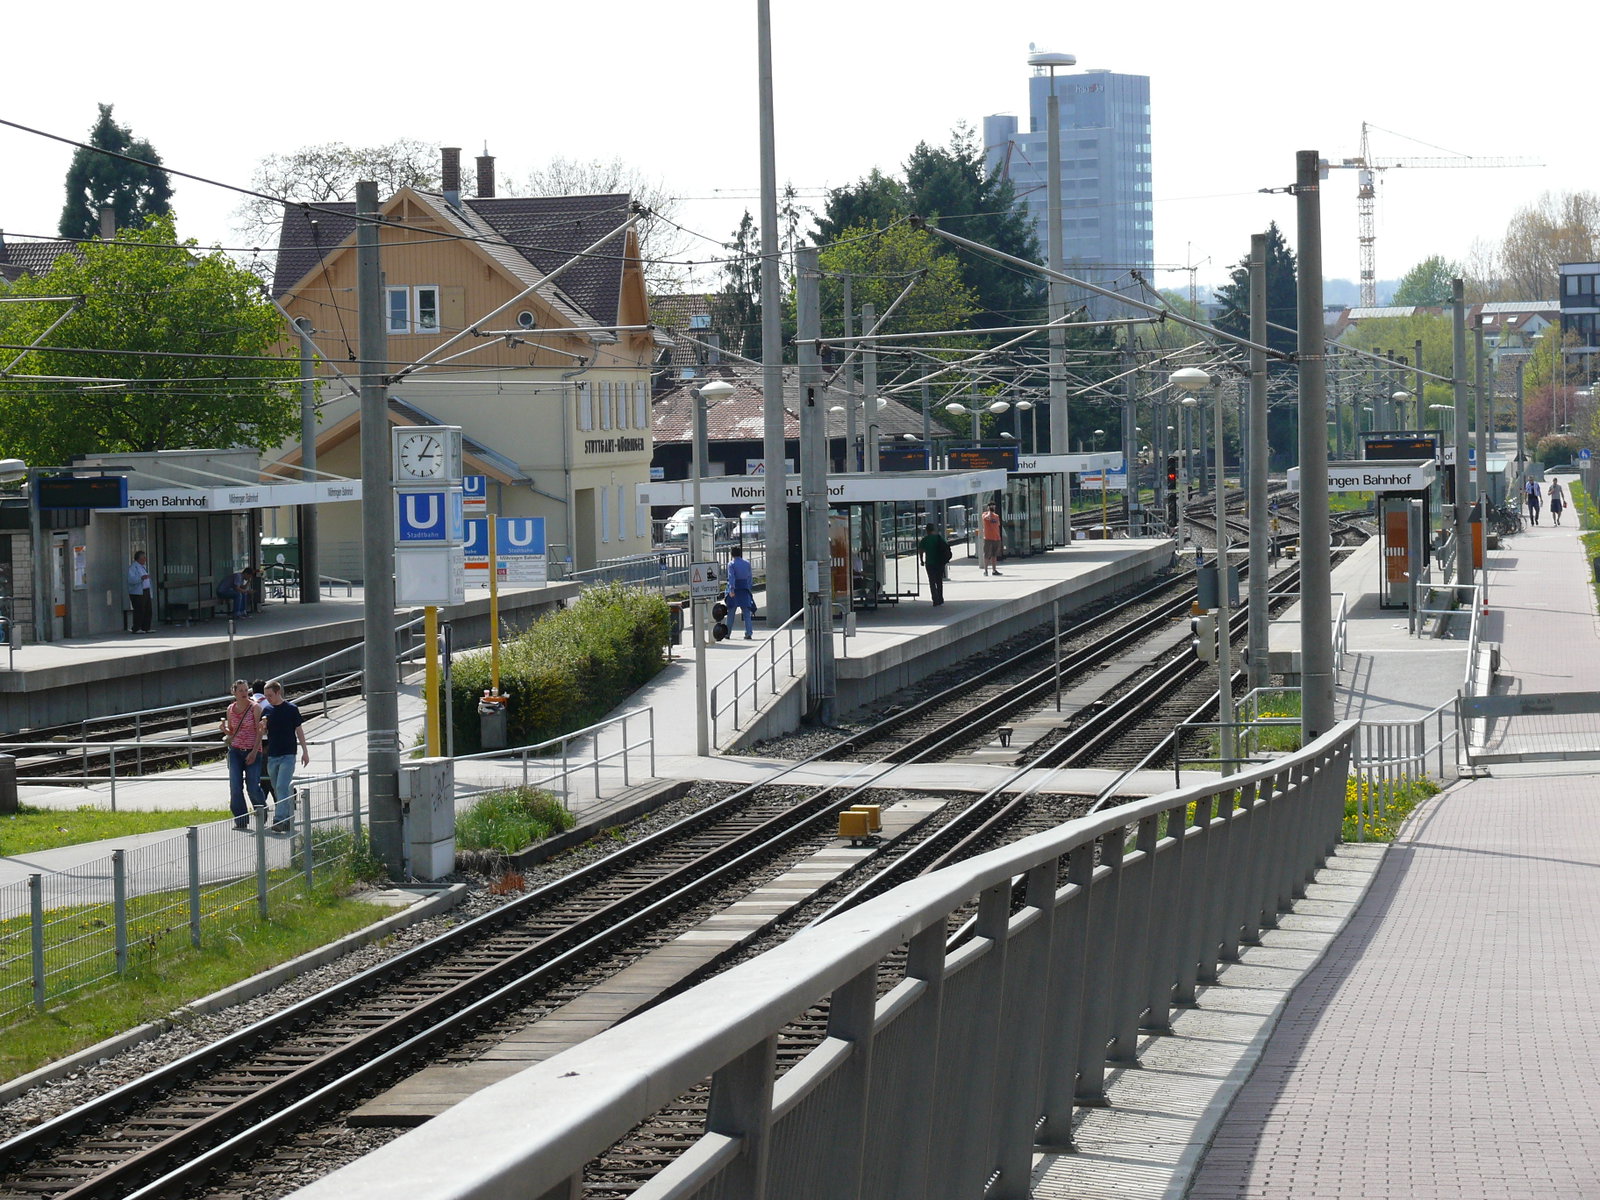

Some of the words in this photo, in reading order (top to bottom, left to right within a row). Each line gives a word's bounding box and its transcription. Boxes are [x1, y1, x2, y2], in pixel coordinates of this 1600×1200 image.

[1018, 461, 1036, 469] nhof
[464, 476, 479, 492] U
[1328, 475, 1359, 488] ingen
[1363, 474, 1411, 485] Bahnhof
[731, 487, 793, 498] Möhrin
[796, 485, 845, 497] Bhof
[161, 495, 206, 507] Bahnhof
[406, 495, 438, 529] U
[508, 520, 533, 547] U
